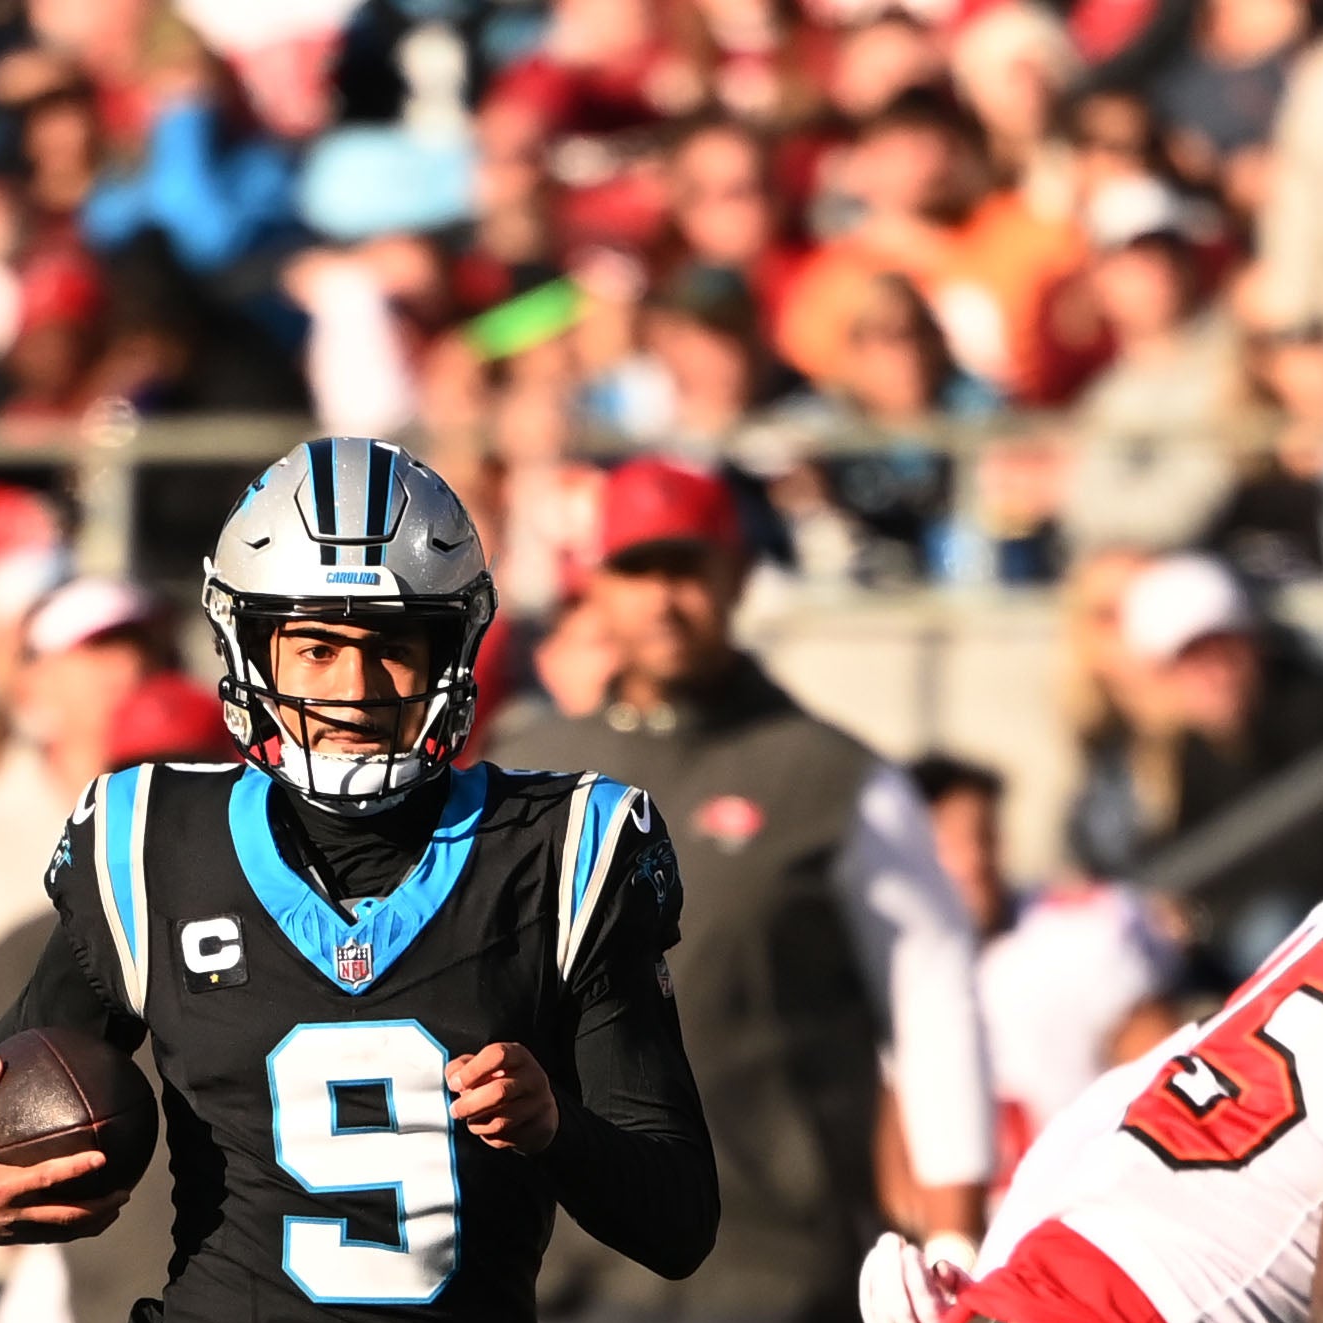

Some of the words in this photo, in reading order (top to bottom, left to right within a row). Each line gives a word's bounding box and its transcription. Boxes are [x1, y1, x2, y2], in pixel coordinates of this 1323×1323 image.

[326, 571, 381, 585] CAROLINA
[181, 917, 241, 974] C
[341, 961, 369, 979] NFL
[266, 1018, 460, 1304] 9
